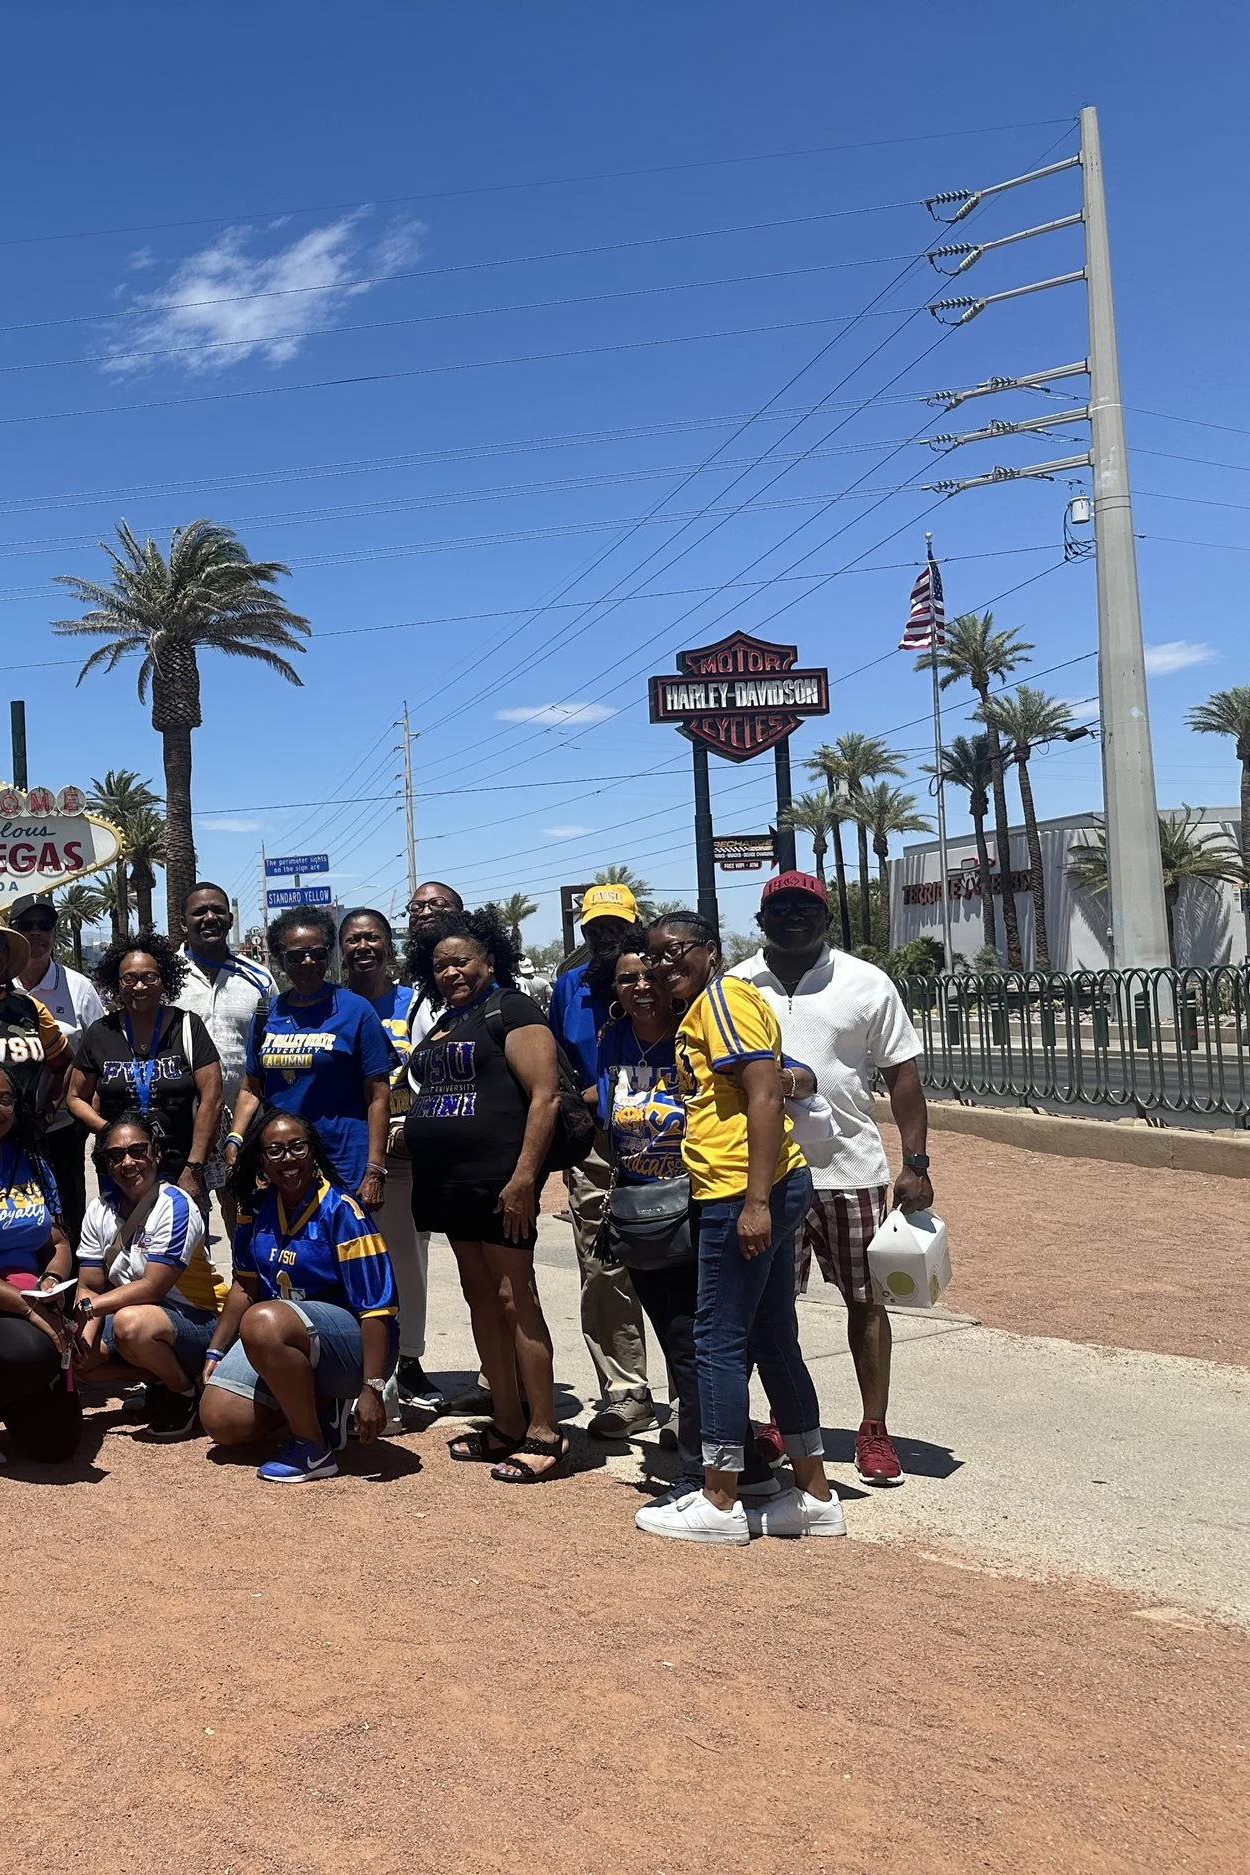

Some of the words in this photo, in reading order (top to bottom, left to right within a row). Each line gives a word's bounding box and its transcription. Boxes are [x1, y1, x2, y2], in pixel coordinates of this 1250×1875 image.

[700, 643, 781, 674] MOTOR
[665, 678, 819, 710] HARLEY-DAVIDSON
[702, 715, 783, 748] CYCLES
[268, 891, 301, 905] STANDARD
[304, 890, 329, 901] YELLOW
[266, 1055, 308, 1066] ALUMNI
